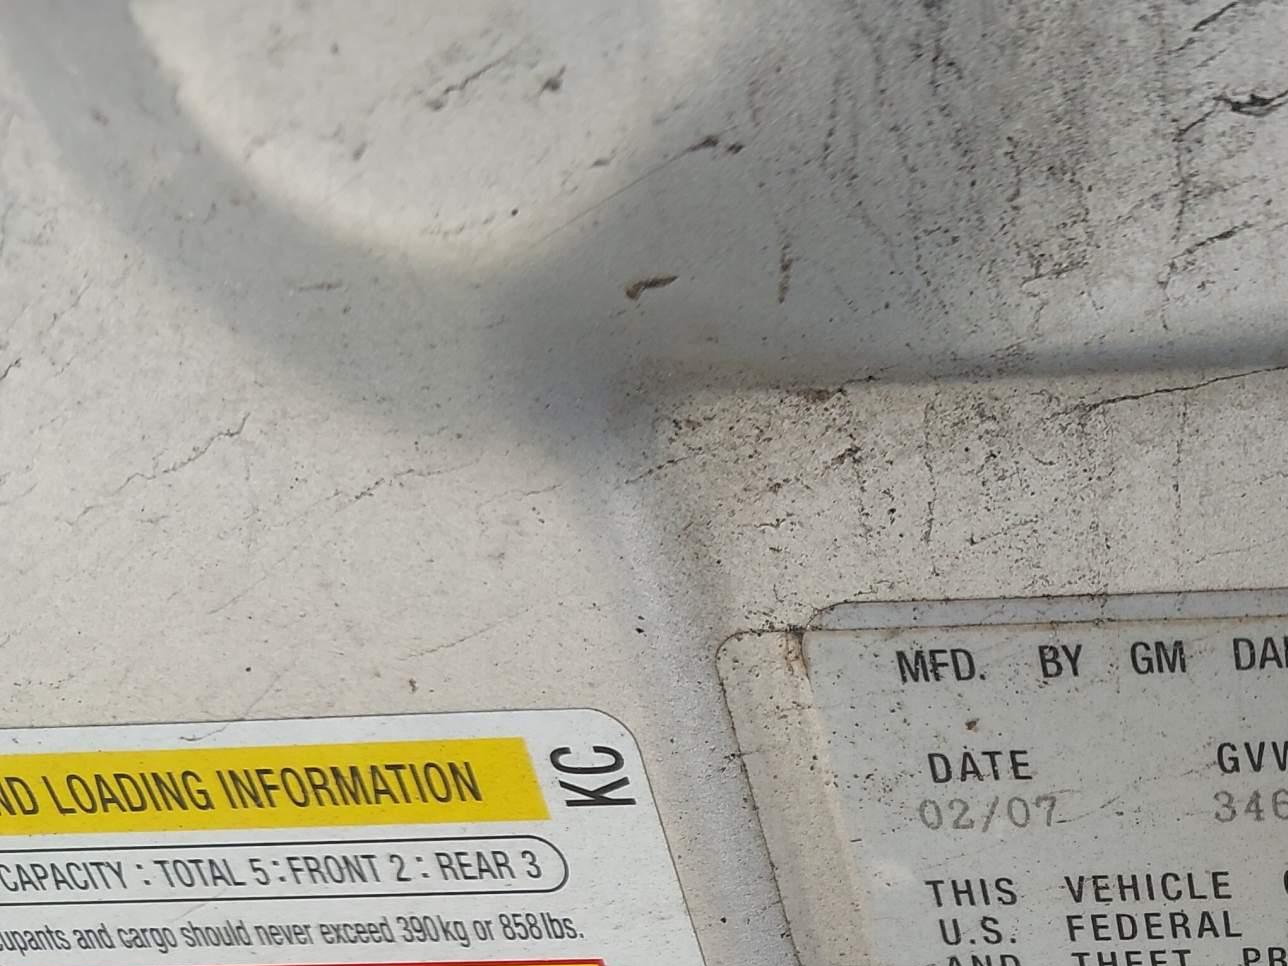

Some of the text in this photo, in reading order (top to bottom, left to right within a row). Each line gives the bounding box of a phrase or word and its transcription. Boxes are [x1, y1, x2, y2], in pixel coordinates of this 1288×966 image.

[896, 648, 987, 684] MFD.
[1037, 644, 1083, 679] BY
[1130, 640, 1187, 674] GM
[550, 745, 636, 807] KC
[927, 750, 1034, 783] DATE
[42, 770, 215, 815] LOADING
[216, 761, 483, 809] INFORMATION
[919, 796, 1060, 833] 02/07
[0, 861, 128, 892] CAPACITY
[153, 858, 246, 888] TOTAL
[435, 850, 515, 880] REAR
[521, 849, 543, 878] 3
[925, 877, 1018, 908] THIS
[1064, 871, 1233, 904] VEHICLE
[72, 923, 114, 949] and
[118, 926, 177, 954] cargo
[184, 920, 252, 948] should
[254, 923, 313, 947] never
[319, 916, 396, 945] exceed
[473, 920, 494, 940] or
[939, 916, 1018, 946] U.S.
[1066, 909, 1243, 942] FEDERAL
